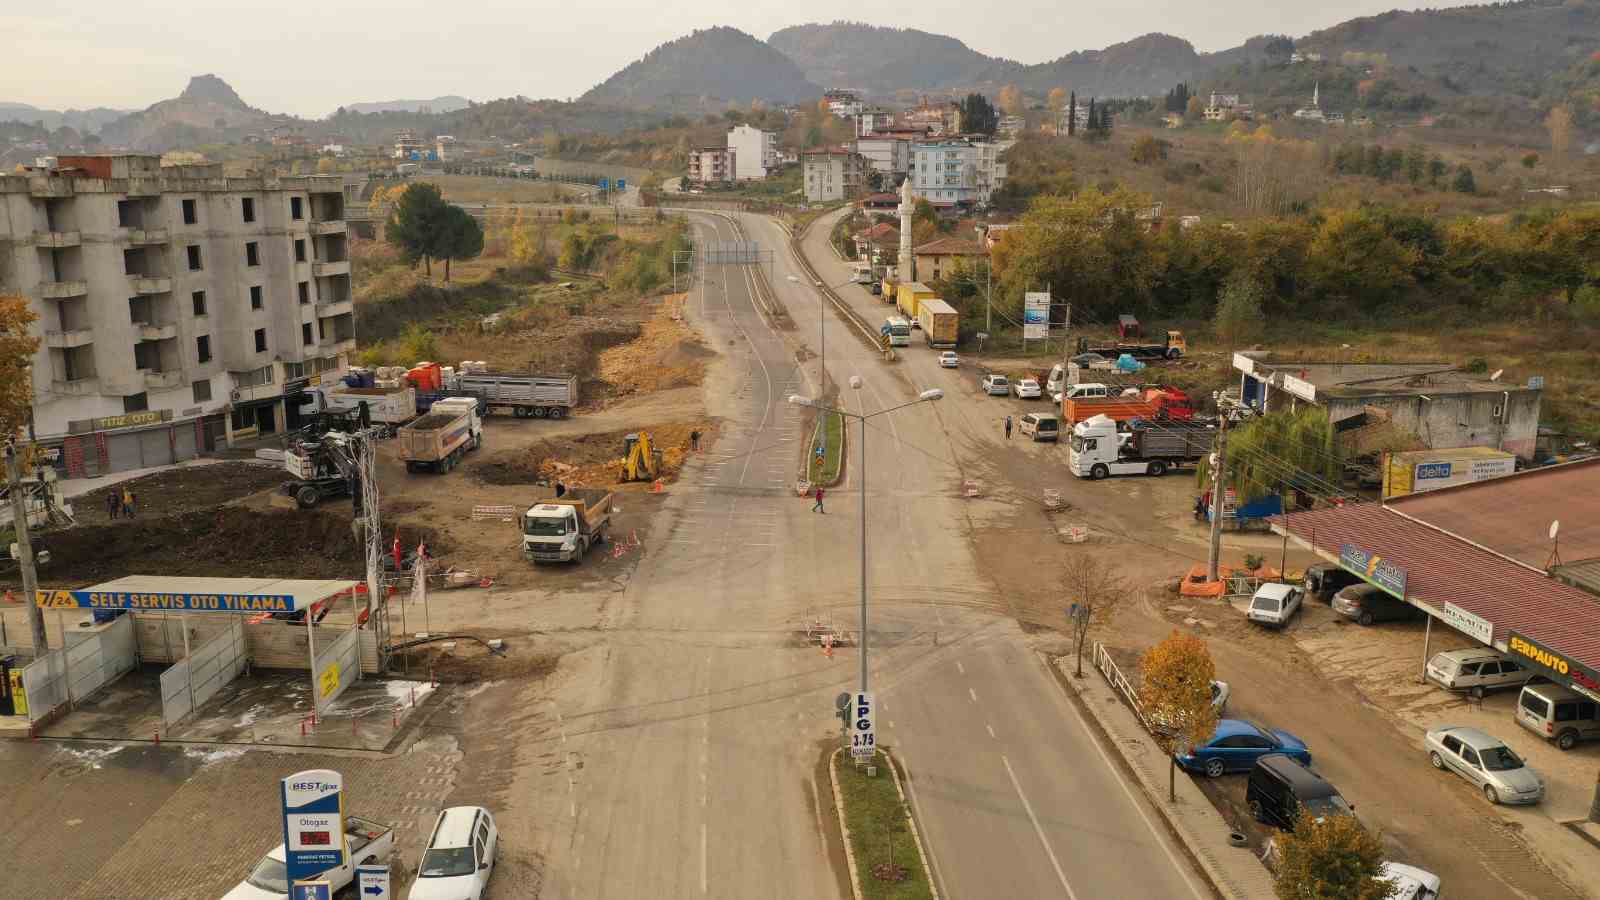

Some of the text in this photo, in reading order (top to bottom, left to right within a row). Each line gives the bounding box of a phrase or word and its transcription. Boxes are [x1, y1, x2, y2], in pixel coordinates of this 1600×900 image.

[132, 412, 155, 424] OTO
[1420, 464, 1449, 478] delta
[39, 592, 287, 610] 7/24 SELF SERVIS OTO YIKAMA
[1510, 637, 1569, 675] SERPAUTO
[856, 694, 871, 730] LPG
[853, 733, 874, 747] 3.75
[299, 818, 328, 827] Otogaz
